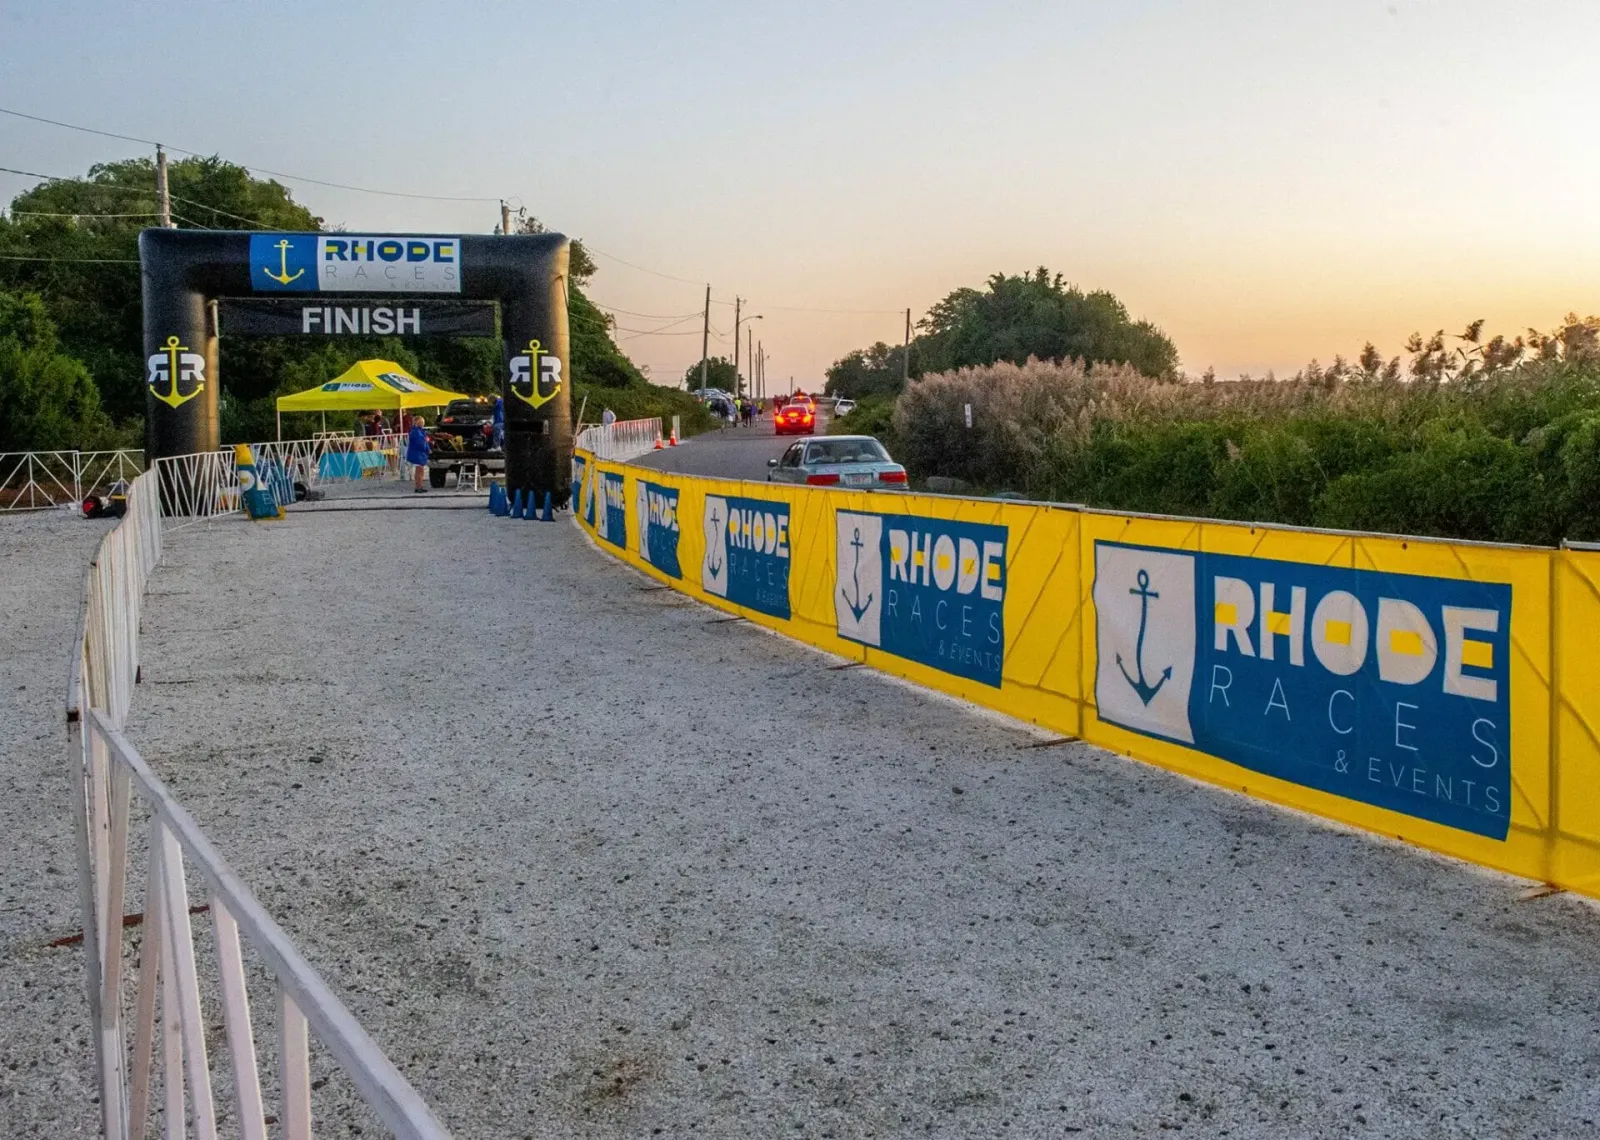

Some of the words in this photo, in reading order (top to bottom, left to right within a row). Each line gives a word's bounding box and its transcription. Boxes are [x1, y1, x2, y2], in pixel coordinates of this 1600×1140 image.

[325, 240, 454, 263] RHODE
[325, 265, 455, 281] RACES
[302, 307, 421, 334] FINISH
[729, 508, 789, 558] RHODE
[730, 553, 788, 589] RACES
[889, 529, 1003, 601] RHODE
[887, 590, 1000, 643] RACES
[1213, 576, 1499, 702] RHODE
[950, 643, 1000, 672] EVENTS
[1209, 665, 1498, 768] RACES
[1334, 749, 1348, 774] &
[1368, 757, 1500, 812] EVENTS
